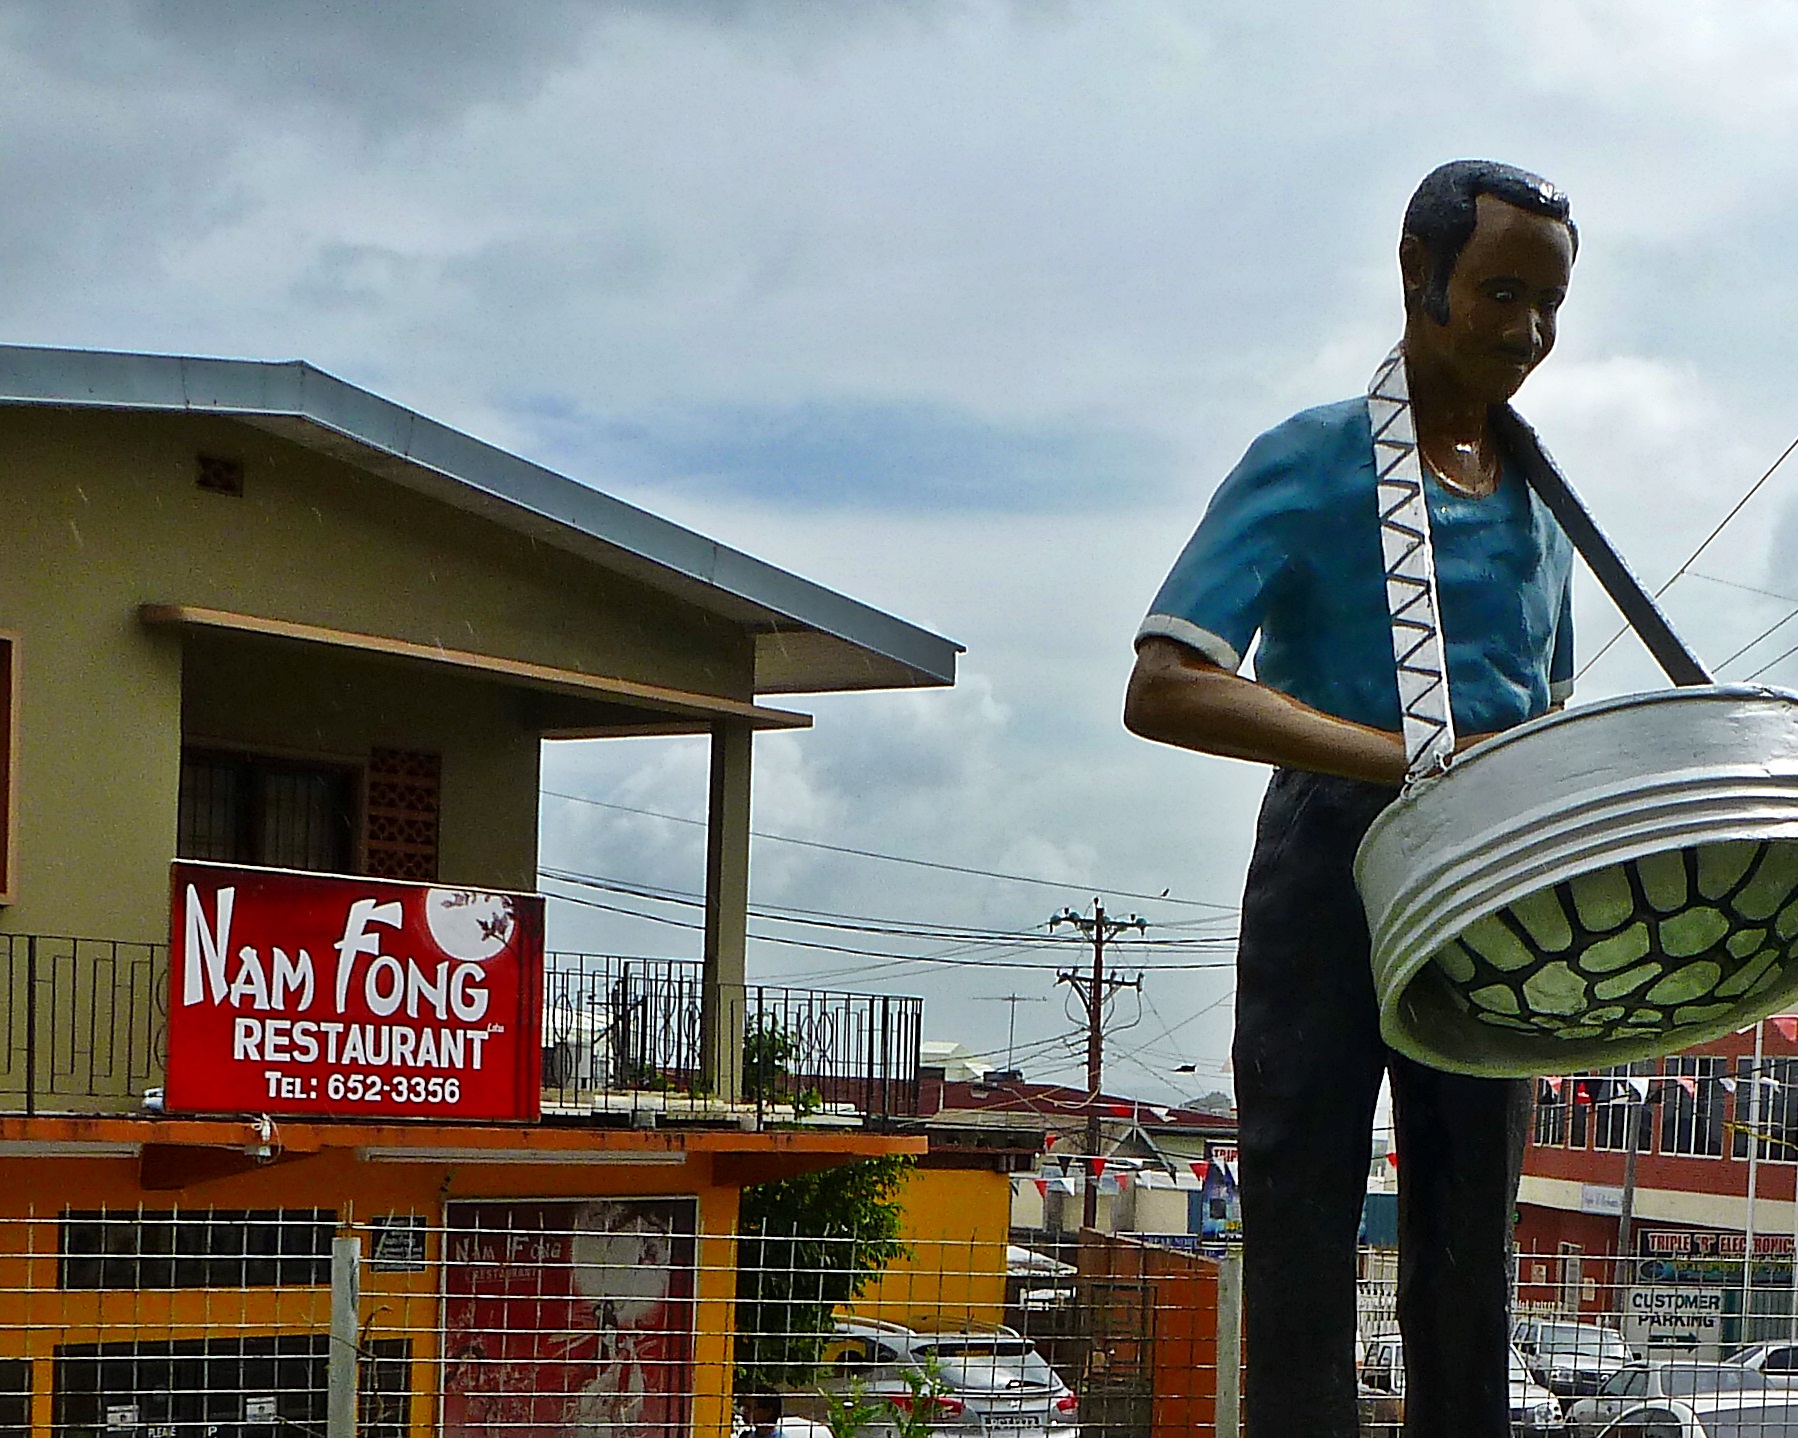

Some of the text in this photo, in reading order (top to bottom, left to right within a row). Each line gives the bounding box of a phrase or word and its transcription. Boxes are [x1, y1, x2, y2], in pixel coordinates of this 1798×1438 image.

[184, 884, 489, 1022] NAM FONG
[233, 1018, 491, 1069] RESTAURANT
[327, 1074, 460, 1103] 652-3356
[455, 1237, 496, 1262] NAM
[1648, 1233, 1691, 1252] TRIPLE
[1632, 1292, 1721, 1310] CUSTOMER
[1637, 1310, 1714, 1328] PARKING
[148, 1426, 176, 1438] PLEAE
